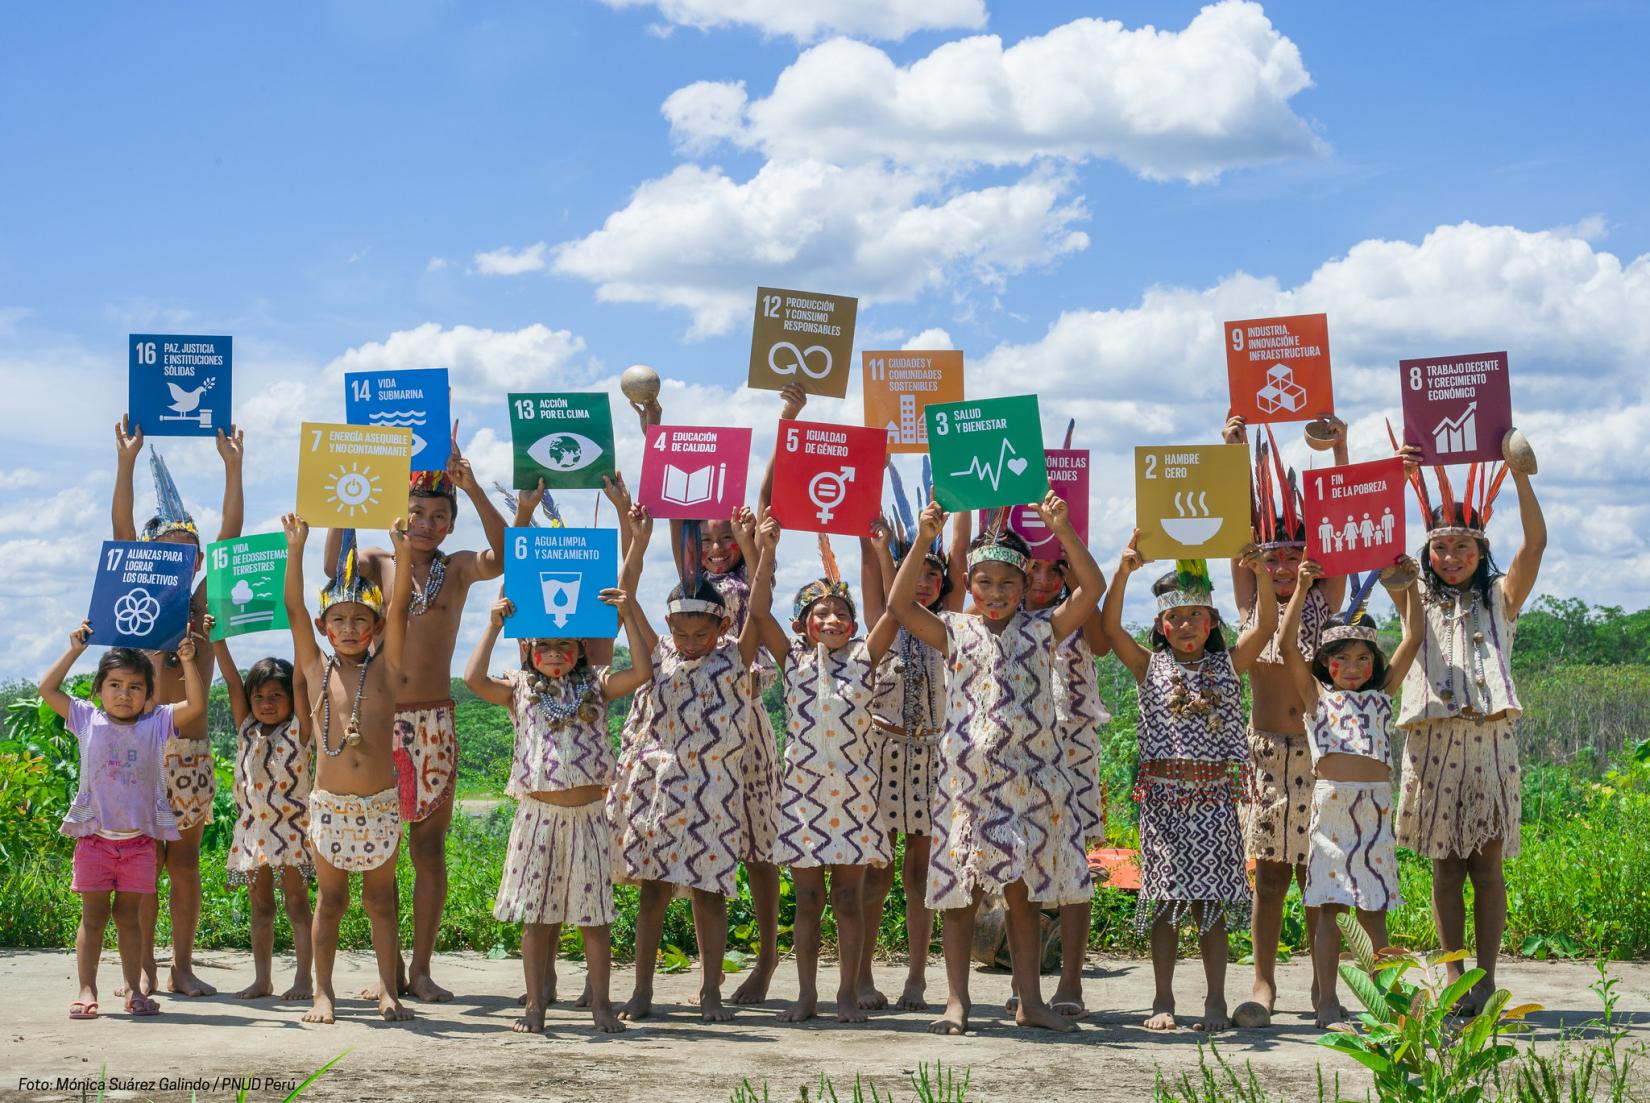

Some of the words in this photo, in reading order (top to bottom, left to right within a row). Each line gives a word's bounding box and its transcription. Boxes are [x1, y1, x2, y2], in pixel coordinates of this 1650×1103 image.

[763, 295, 782, 318] 12
[786, 297, 834, 311] PRODUCCIÓN
[785, 310, 791, 319] Y
[791, 310, 828, 322] CONSUMO
[784, 320, 840, 336] RESPONSABLES
[1248, 325, 1290, 336] INDUSTRIA,
[1232, 328, 1243, 351] 9
[1249, 335, 1294, 349] INNOVACIÓN
[1295, 336, 1299, 345] E
[136, 342, 156, 364] 16
[164, 344, 180, 354] PAZ,
[181, 344, 214, 354] JUSTICIA
[1249, 346, 1320, 361] INFRAESTRUCTURA
[164, 356, 169, 365] E
[170, 356, 223, 366] INSTITUCIONES
[889, 359, 925, 368] CIUDADES
[927, 359, 932, 368] Y
[1427, 364, 1464, 376] TRABAJO
[1465, 360, 1499, 373] DECENTE
[164, 366, 194, 376] SÓLIDAS
[869, 359, 885, 381] 11
[889, 370, 942, 379] COMUNIDADES
[378, 379, 396, 388] VIDA
[1410, 367, 1422, 391] 8
[1427, 379, 1433, 388] Y
[1434, 374, 1486, 388] CRECIMIENTO
[351, 379, 371, 402] 14
[889, 382, 938, 391] SOSTENIBLES
[1428, 386, 1475, 401] ECONÓMICO
[378, 389, 423, 401] SUBMARINA
[514, 400, 535, 419] 13
[540, 399, 567, 408] ACCIÓN
[541, 410, 556, 419] POR
[556, 410, 566, 418] EL
[567, 410, 589, 419] CLIMA
[954, 408, 981, 420] SALUD
[936, 412, 949, 436] 3
[955, 422, 962, 433] Y
[962, 419, 1007, 433] BIENESTAR
[312, 430, 322, 452] 7
[330, 430, 364, 442] ENERGÍA
[365, 433, 408, 445] ASEQUIBLE
[654, 432, 667, 451] 4
[672, 431, 717, 442] EDUCACIÓN
[786, 429, 800, 452] 5
[806, 430, 846, 443] IGUALDAD
[329, 444, 335, 453] Y
[336, 445, 346, 454] NO
[346, 445, 408, 457] CONTAMINANTE
[672, 442, 682, 452] DE
[683, 443, 716, 453] CALIDAD
[805, 444, 817, 454] DE
[817, 443, 848, 457] GÉNERO
[1045, 456, 1057, 468] ÓN
[1059, 458, 1070, 467] DE
[1071, 458, 1086, 468] LAS
[1165, 453, 1199, 465] HAMBRE
[1145, 454, 1157, 479] 2
[1165, 467, 1187, 478] CERO
[1332, 474, 1343, 486] FIN
[1315, 477, 1323, 501] 1
[1332, 488, 1342, 499] DE
[1343, 486, 1353, 497] LA
[1353, 481, 1387, 496] POBREZA
[233, 543, 248, 553] VIDA
[515, 536, 527, 560] 6
[535, 536, 557, 547] AGUA
[559, 536, 586, 546] LIMPIA
[107, 548, 123, 571] 17
[128, 548, 162, 561] ALIANZAS
[163, 552, 182, 562] PARA
[211, 547, 228, 570] 15
[233, 555, 241, 565] DE
[535, 549, 541, 559] Y
[542, 549, 599, 560] SANEAMIENTO
[125, 561, 153, 572] LOGRAR
[233, 562, 275, 576] TERRESTRES
[123, 572, 137, 583] LOS
[137, 573, 178, 586] OBJETIVOS
